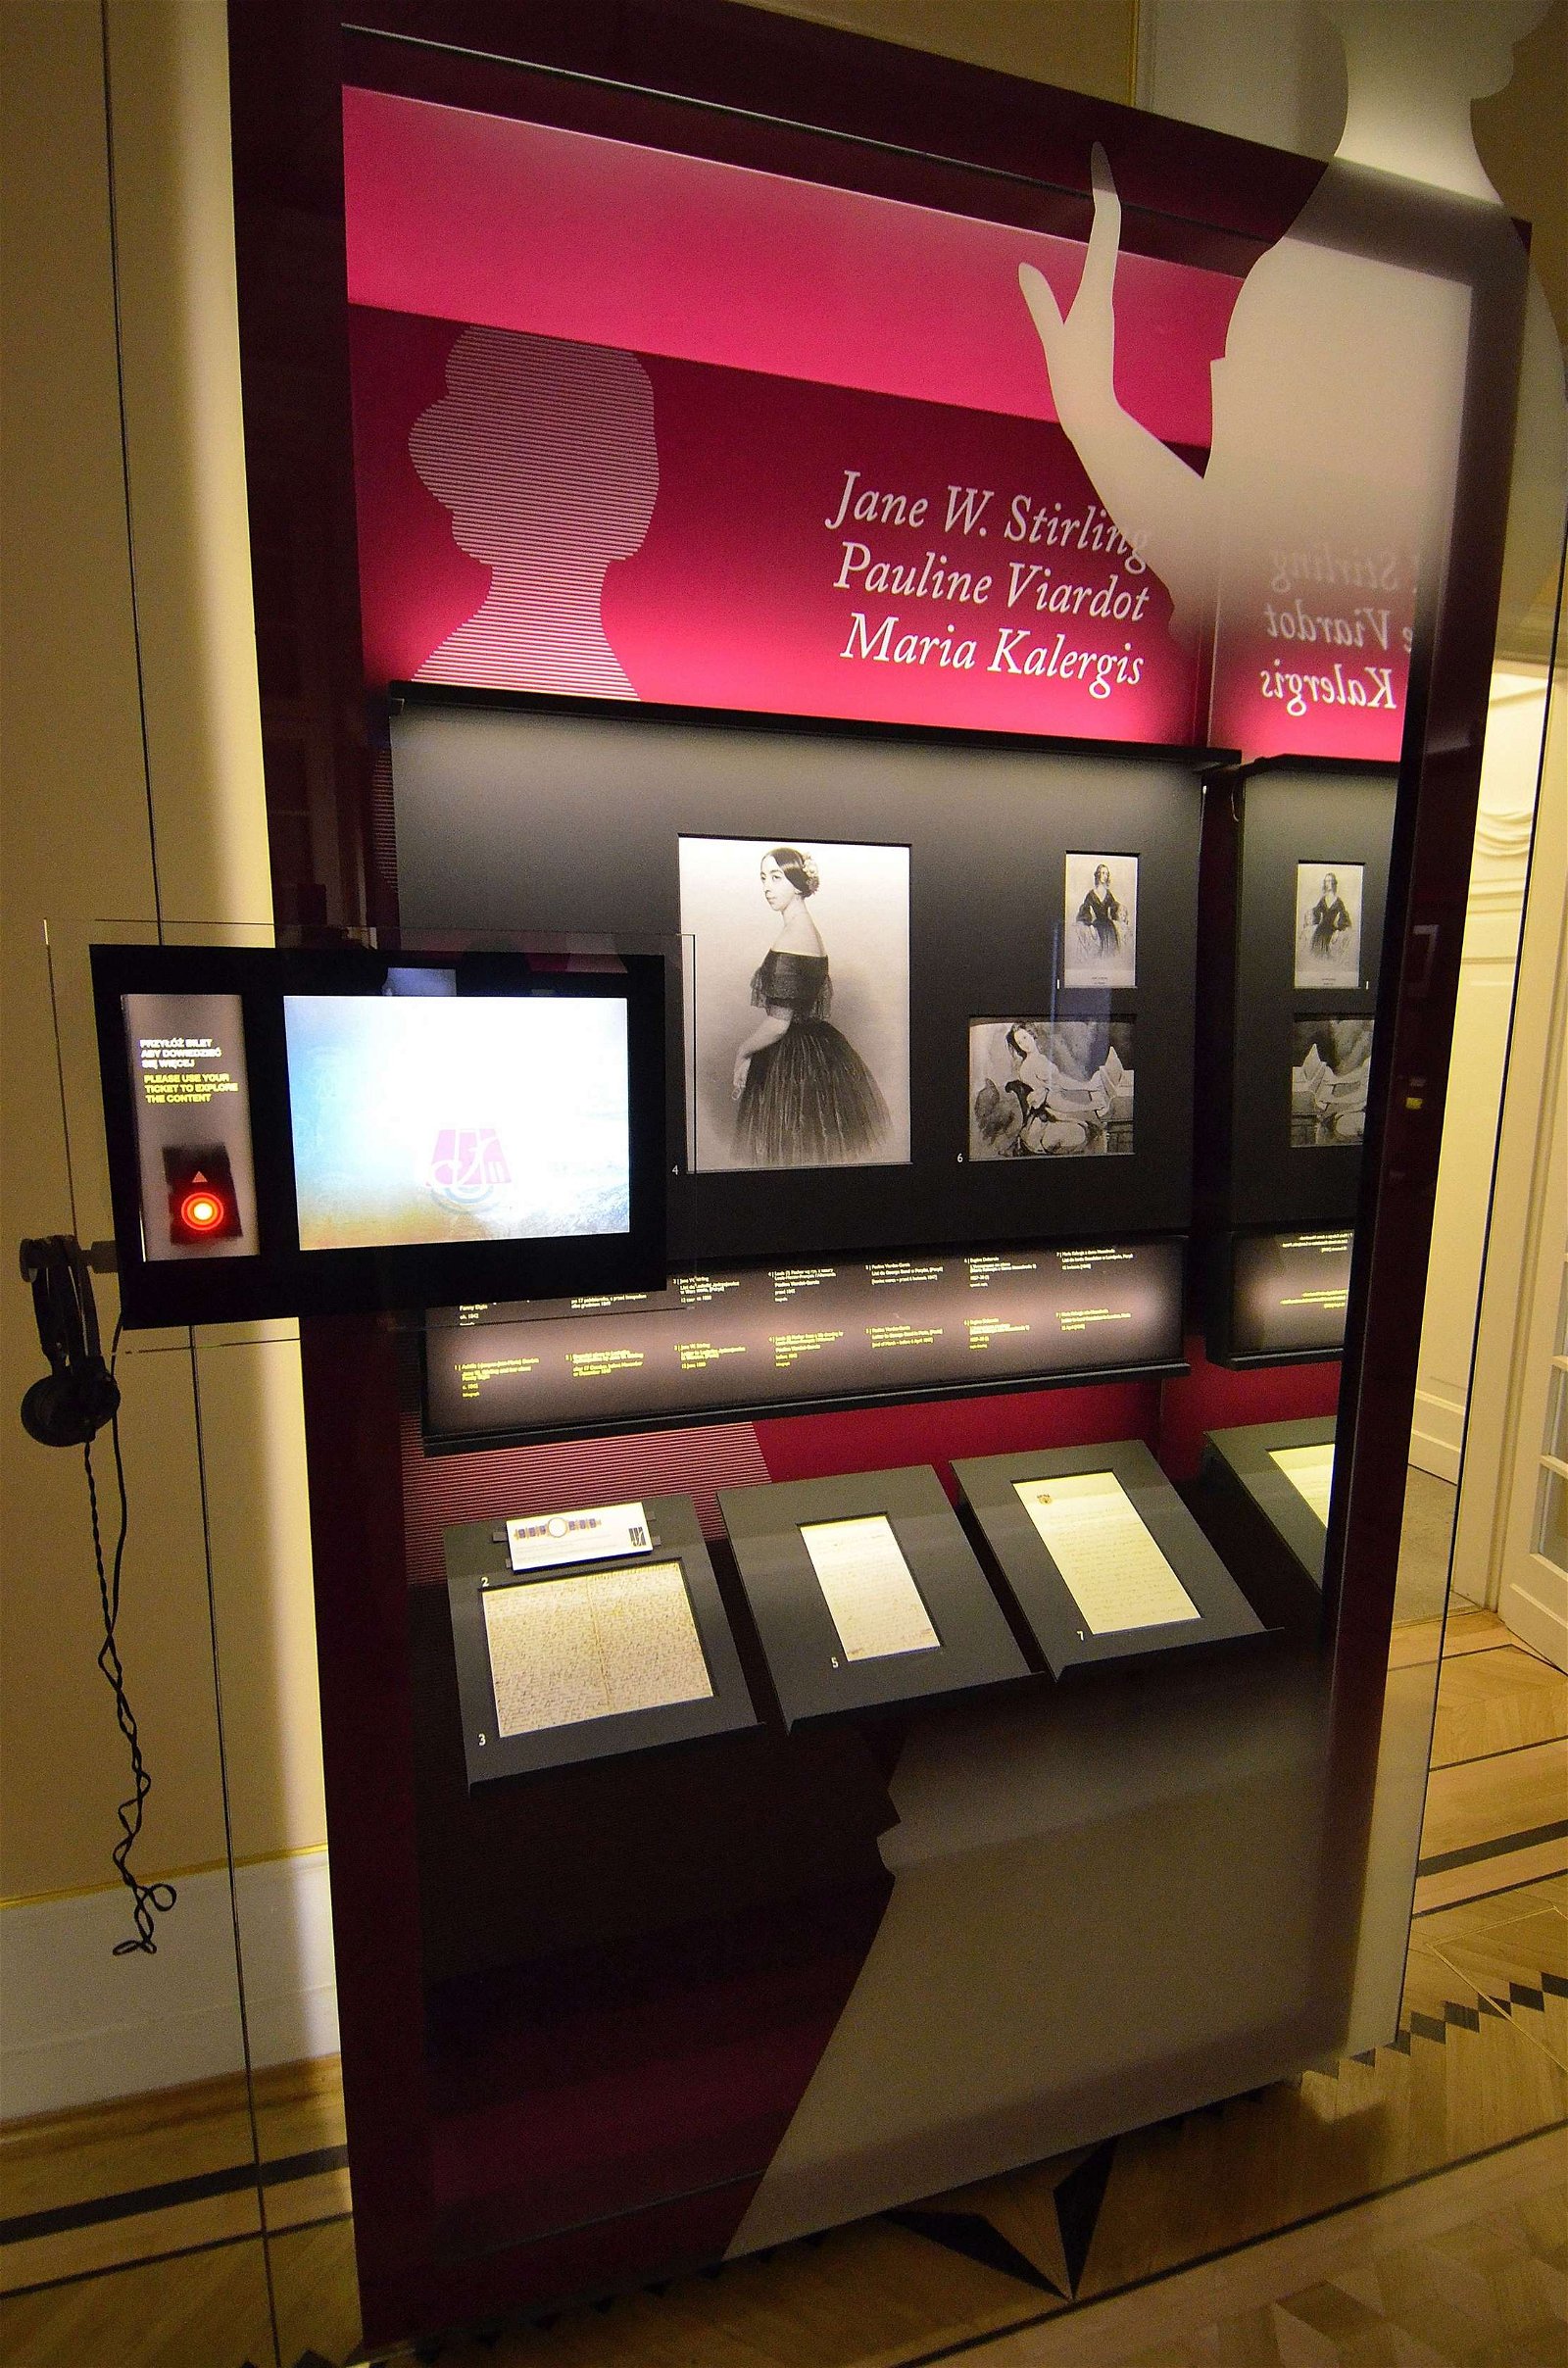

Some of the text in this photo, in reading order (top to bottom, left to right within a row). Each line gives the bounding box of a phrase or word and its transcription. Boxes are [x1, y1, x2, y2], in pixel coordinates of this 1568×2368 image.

[824, 469, 1150, 575] Jane W. Stirling
[833, 541, 1151, 622] Pauline Viardot
[839, 612, 1145, 700] Maria Kalergis
[144, 1072, 230, 1083] PLEASE USE YOUR
[144, 1082, 239, 1094] TICKET TO EXPLORE
[145, 1093, 212, 1104] THE CONTENT
[956, 1153, 963, 1163] 6
[671, 1164, 679, 1176] 4
[481, 1577, 490, 1588] 2
[1076, 1630, 1085, 1642] 7
[831, 1656, 839, 1669] 5
[478, 1733, 486, 1747] 3
